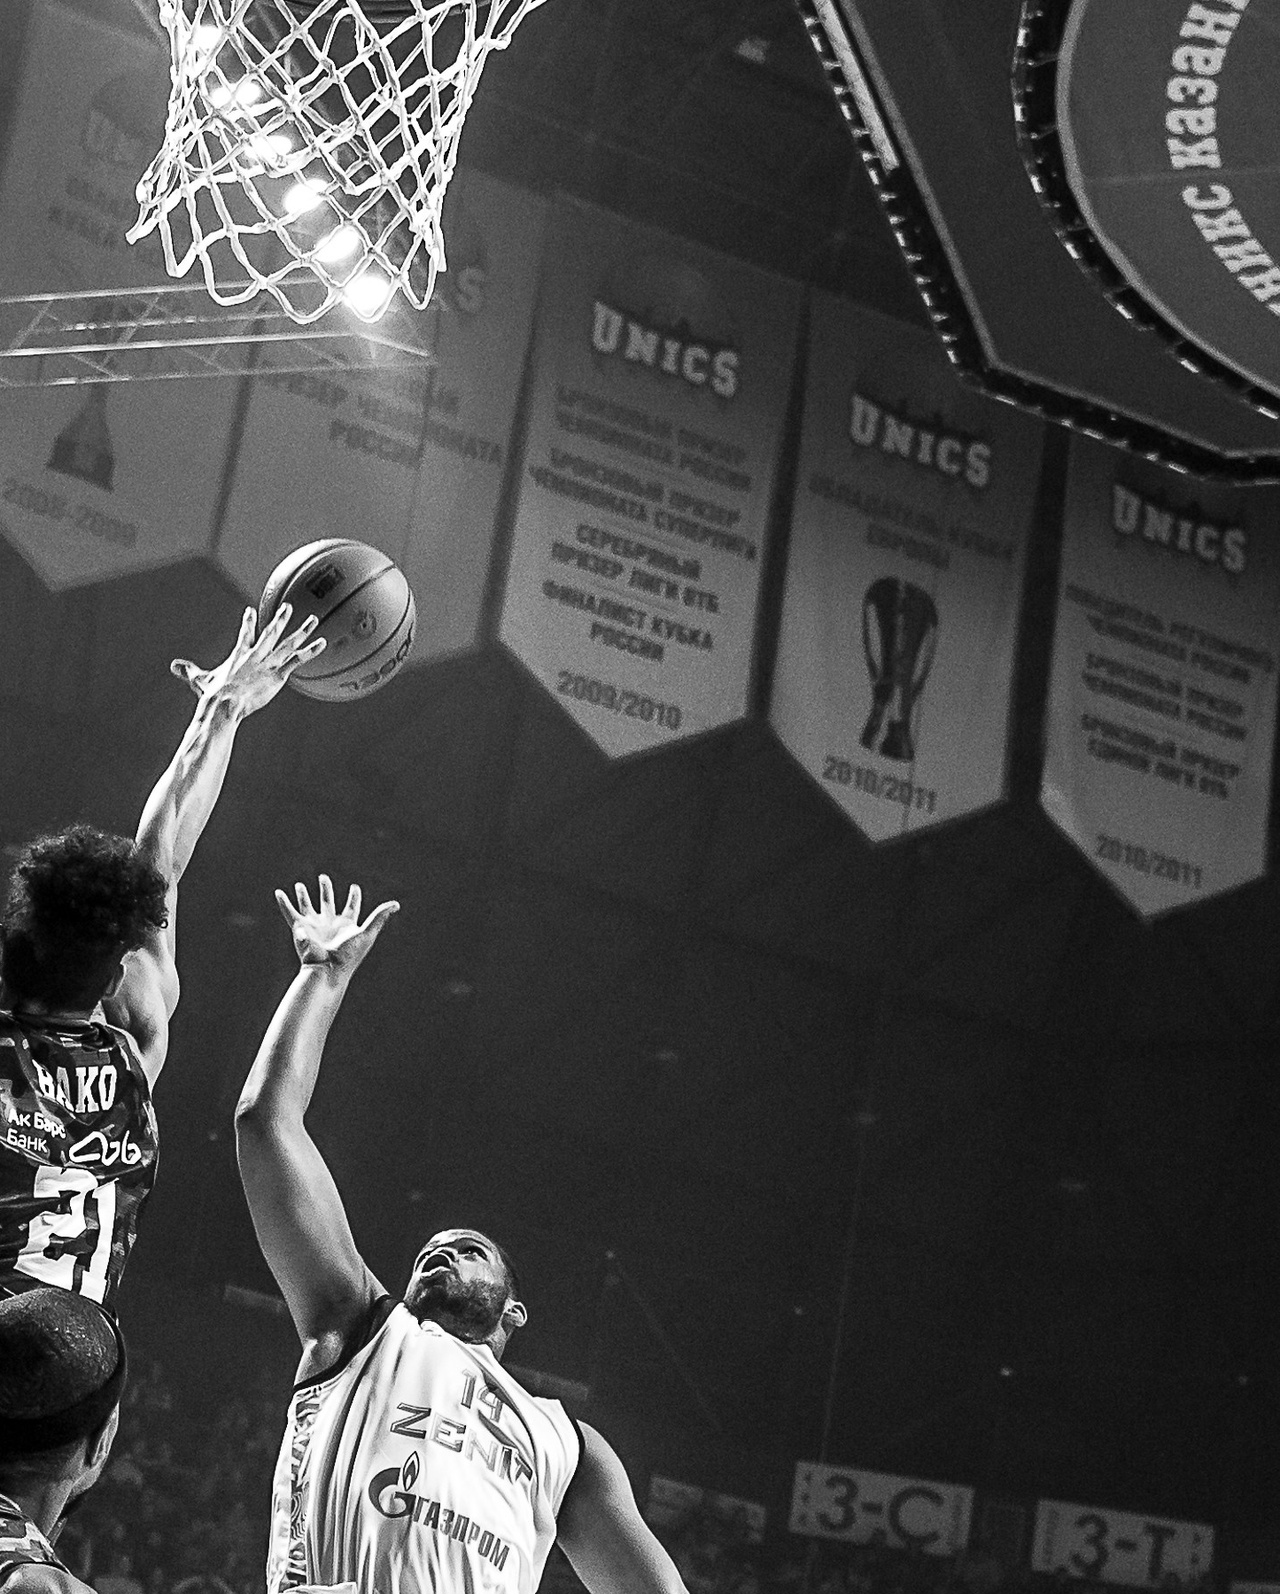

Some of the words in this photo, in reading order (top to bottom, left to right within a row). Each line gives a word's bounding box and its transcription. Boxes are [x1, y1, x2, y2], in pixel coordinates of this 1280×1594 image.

[1182, 184, 1280, 316] никс
[591, 300, 741, 399] UNICS
[850, 393, 993, 489] UNICS
[1113, 483, 1247, 574] UNICS
[542, 579, 647, 630] ФИНАЛИСТ
[651, 615, 714, 653] КУБКА
[557, 669, 684, 732] 2009/2010
[823, 755, 937, 815] 2010/2011
[6, 1127, 49, 1154] Банк
[14, 1165, 119, 1305] 21
[390, 1402, 534, 1485] ZENIT
[412, 1495, 511, 1572] ГАЗПРОМ
